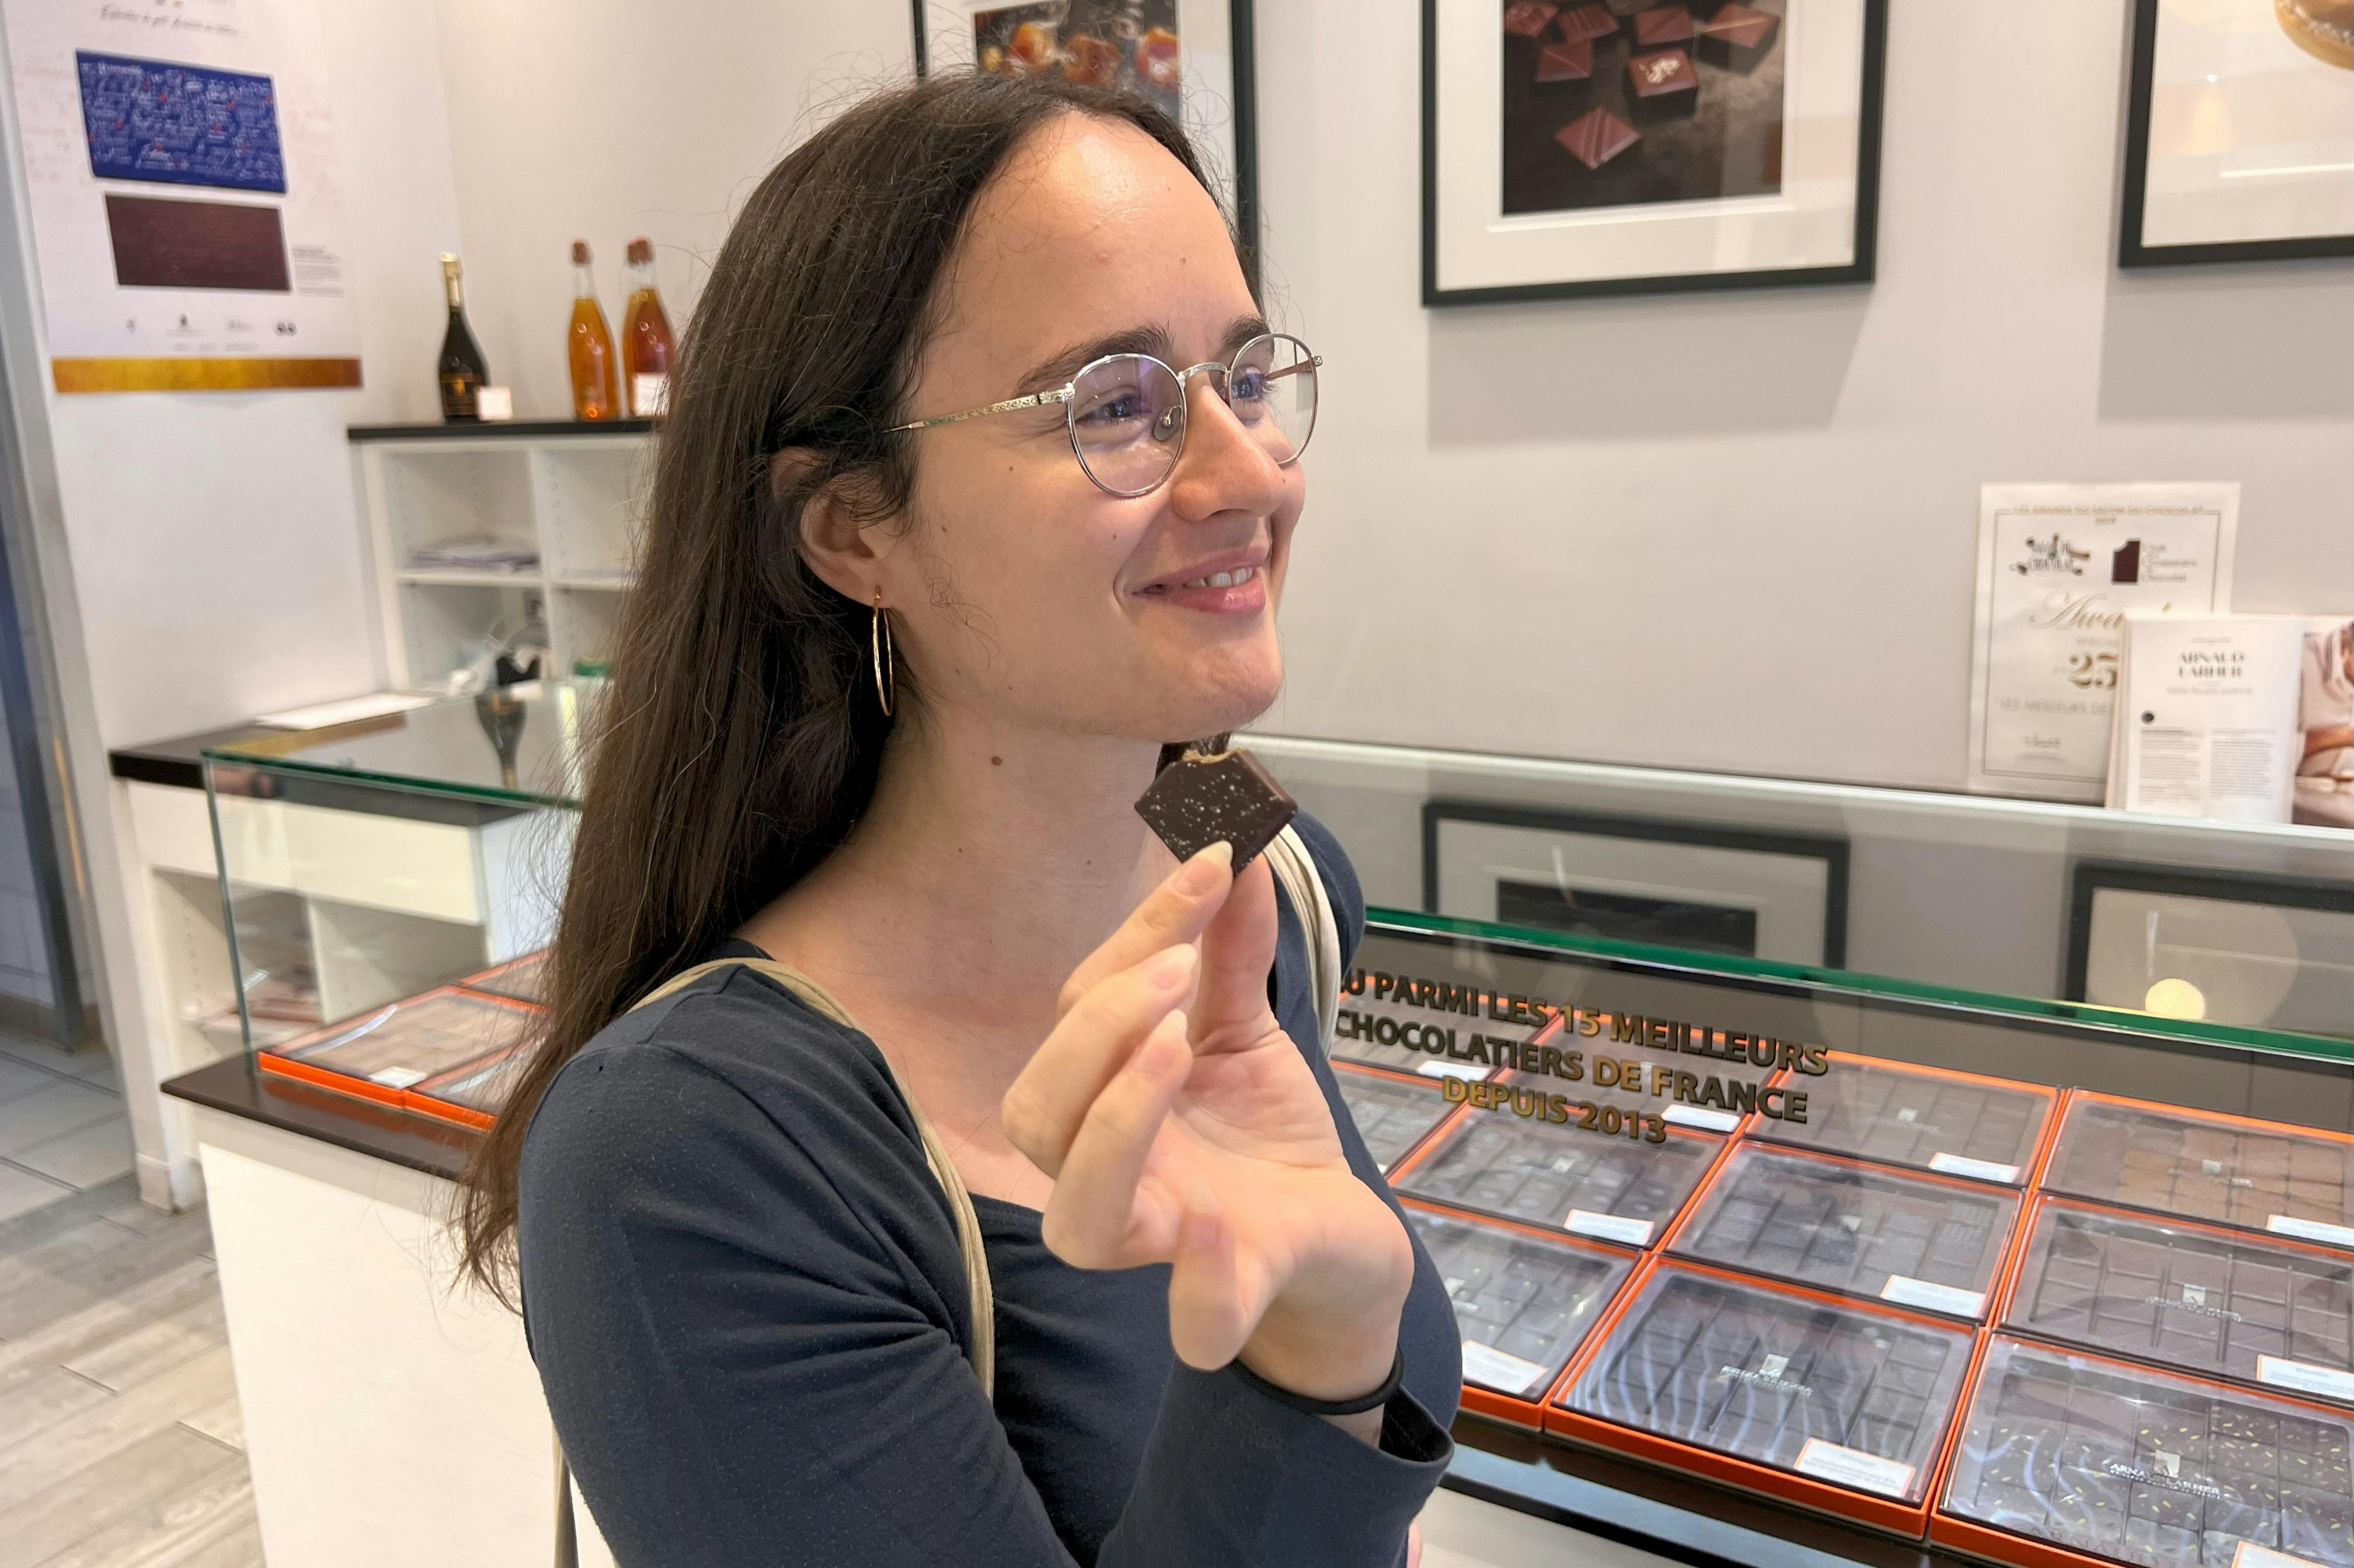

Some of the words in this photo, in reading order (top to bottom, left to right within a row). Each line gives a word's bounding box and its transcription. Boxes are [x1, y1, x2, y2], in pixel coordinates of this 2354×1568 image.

[1335, 1008, 1585, 1081] CHOCOLATIERS
[1592, 1054, 1642, 1092] DE
[1651, 1064, 1808, 1124] FRANCE
[1342, 967, 1366, 996] U
[1374, 971, 1479, 1016] PARMI
[1486, 989, 1548, 1028] LES
[1560, 1003, 1600, 1037] 15
[1610, 1011, 1828, 1076] MEILLEURS
[1442, 1075, 1569, 1124] DEPUIS
[1578, 1100, 1666, 1144] 2013
